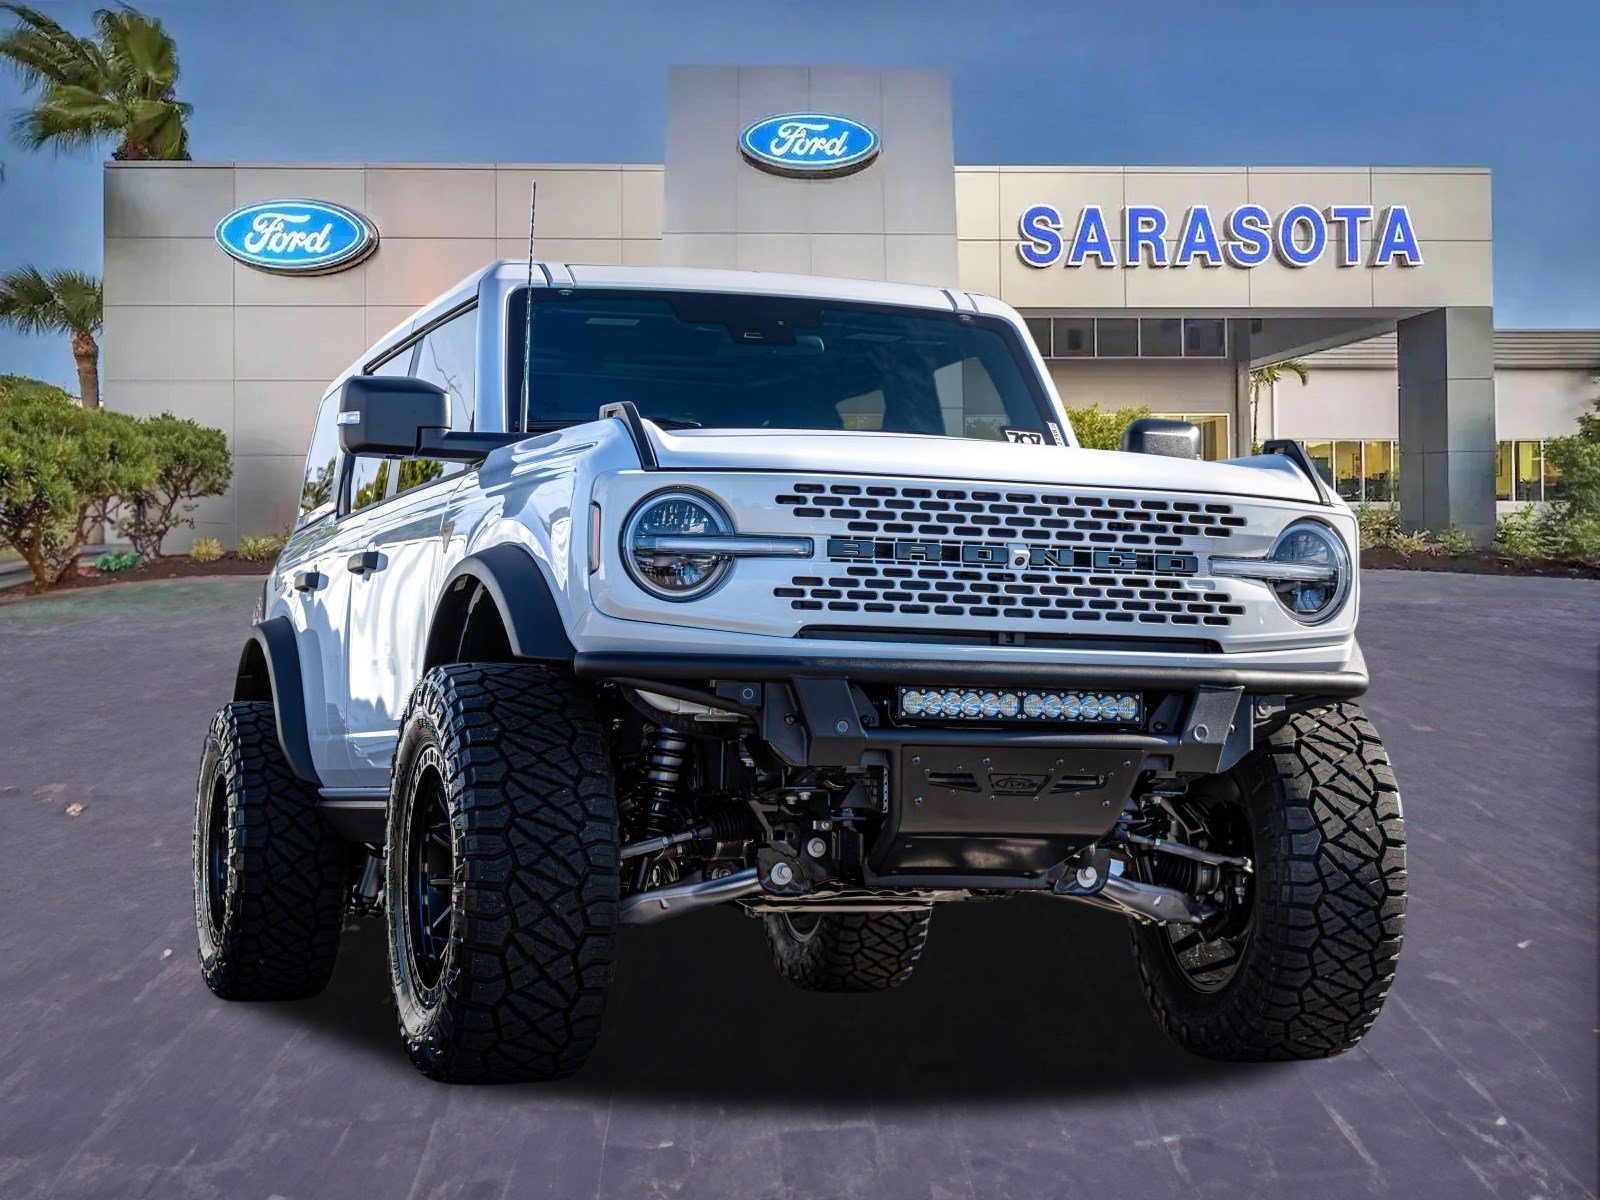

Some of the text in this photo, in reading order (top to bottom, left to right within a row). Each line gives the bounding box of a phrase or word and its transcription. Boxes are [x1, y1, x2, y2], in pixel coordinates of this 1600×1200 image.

[769, 121, 849, 157] Ford
[244, 212, 332, 255] Ford
[1017, 203, 1425, 269] SARASOTA
[826, 537, 1199, 574] BRONCO
